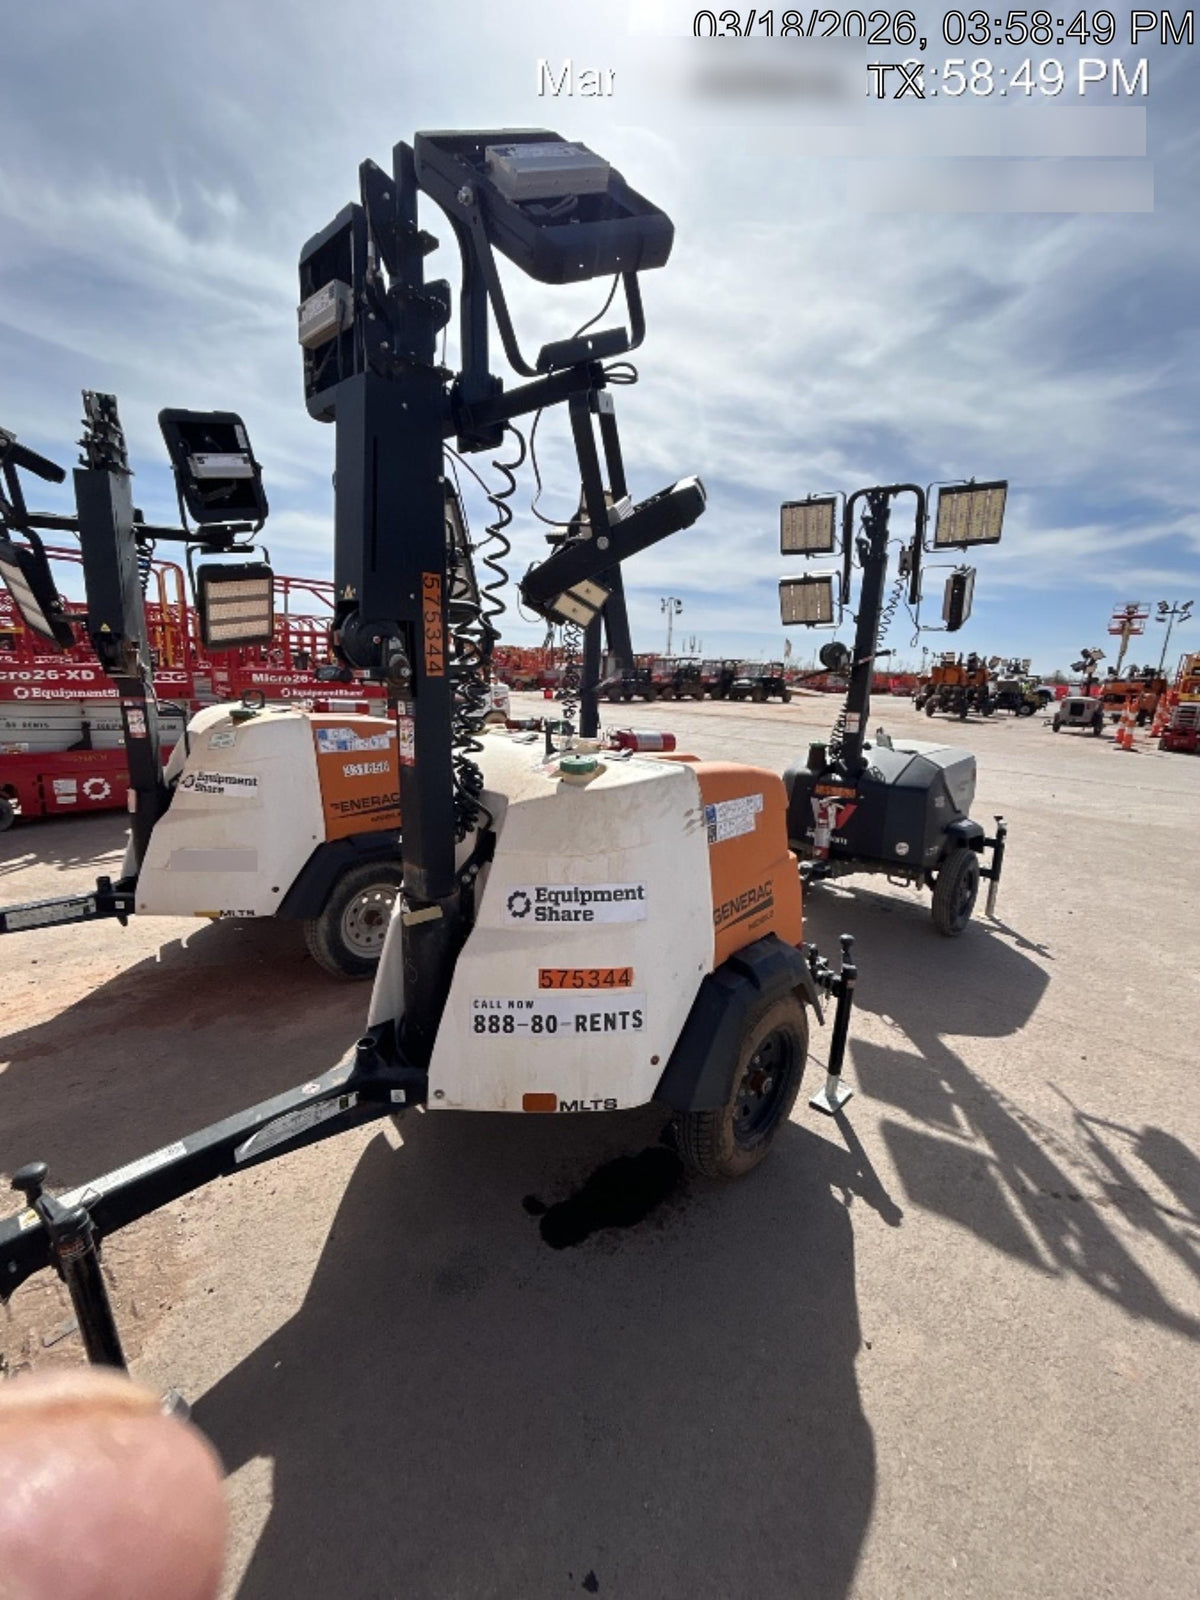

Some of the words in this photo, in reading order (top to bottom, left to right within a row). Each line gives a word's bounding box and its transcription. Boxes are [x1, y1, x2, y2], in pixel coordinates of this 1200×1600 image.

[424, 575, 443, 674] 575344
[534, 885, 645, 906] Equipment
[713, 881, 774, 924] GENERAC
[534, 906, 594, 922] Share
[541, 968, 632, 989] 575344
[473, 1000, 502, 1009] CALL
[508, 1000, 535, 1009] NOW
[473, 1009, 644, 1034] 888-80-RENTS
